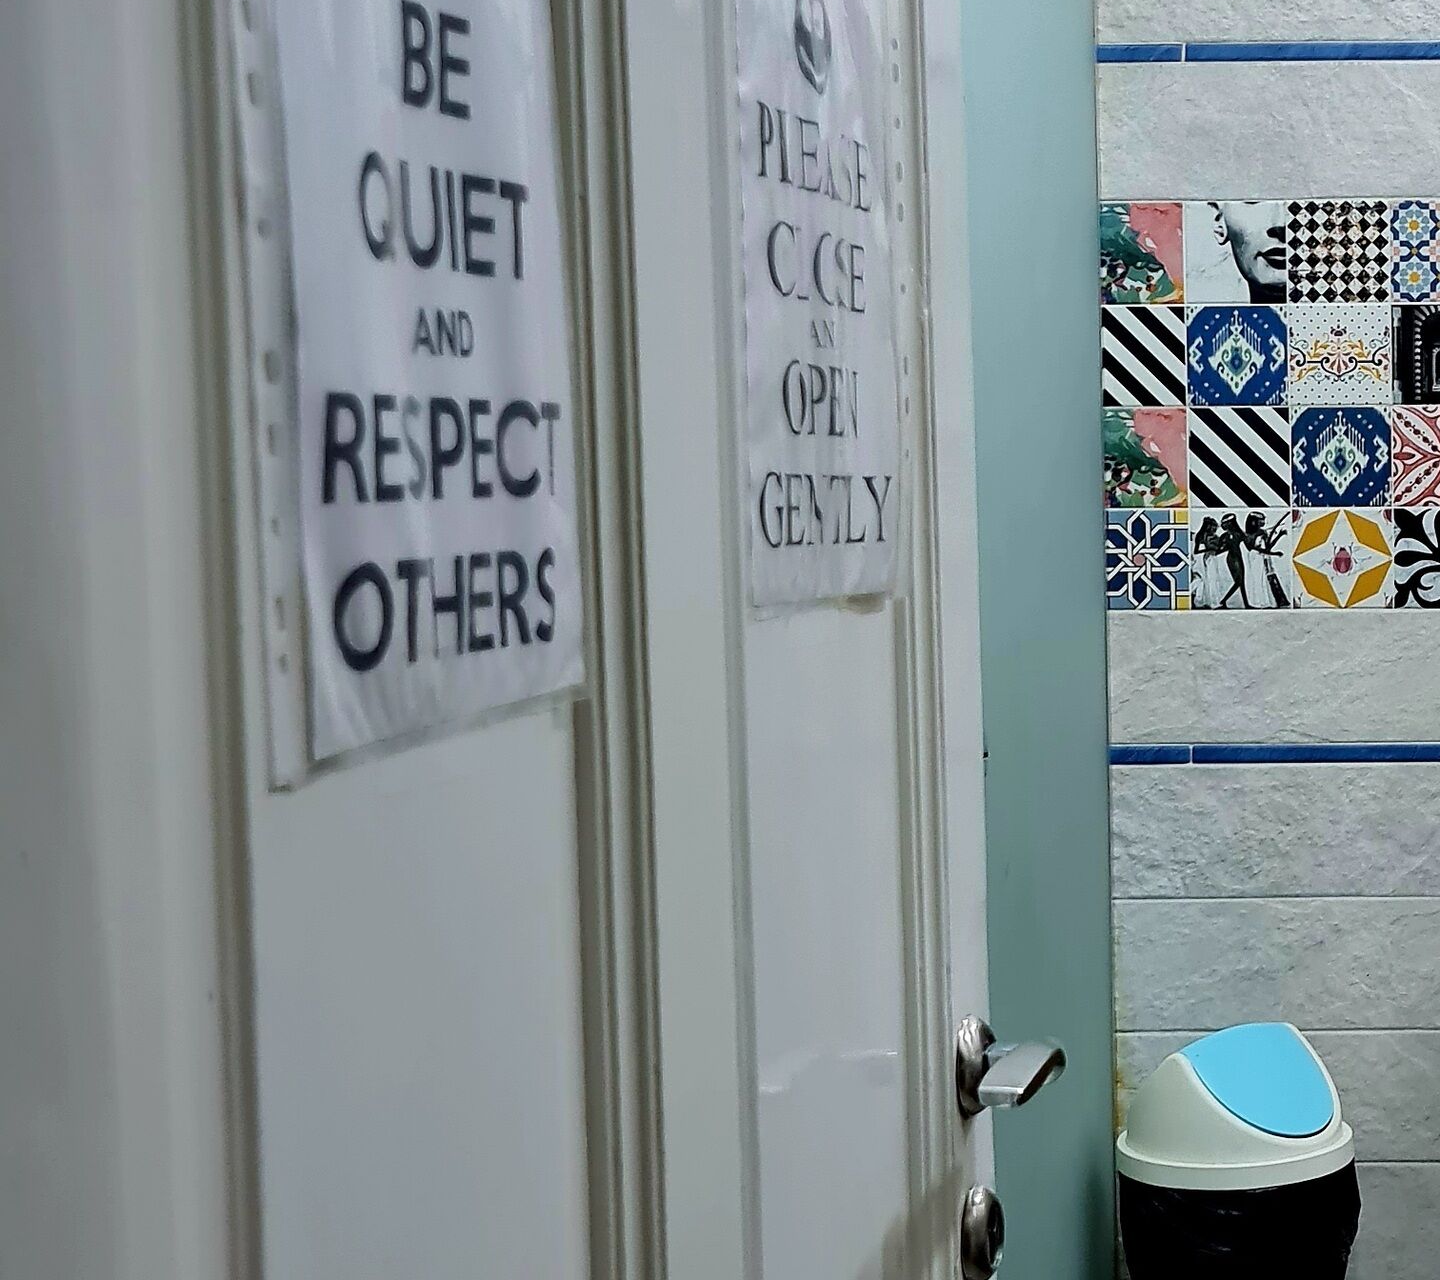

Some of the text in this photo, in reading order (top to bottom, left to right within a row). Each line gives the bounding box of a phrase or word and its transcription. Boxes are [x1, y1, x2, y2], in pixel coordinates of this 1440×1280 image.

[401, 0, 472, 120] BE
[359, 149, 529, 280] QUIET
[767, 220, 866, 314] COSE
[413, 307, 474, 358] AND
[323, 391, 562, 504] RESPECT
[782, 359, 859, 439] OPEN
[759, 471, 893, 549] GENTLY
[334, 546, 556, 672] OTHERS
